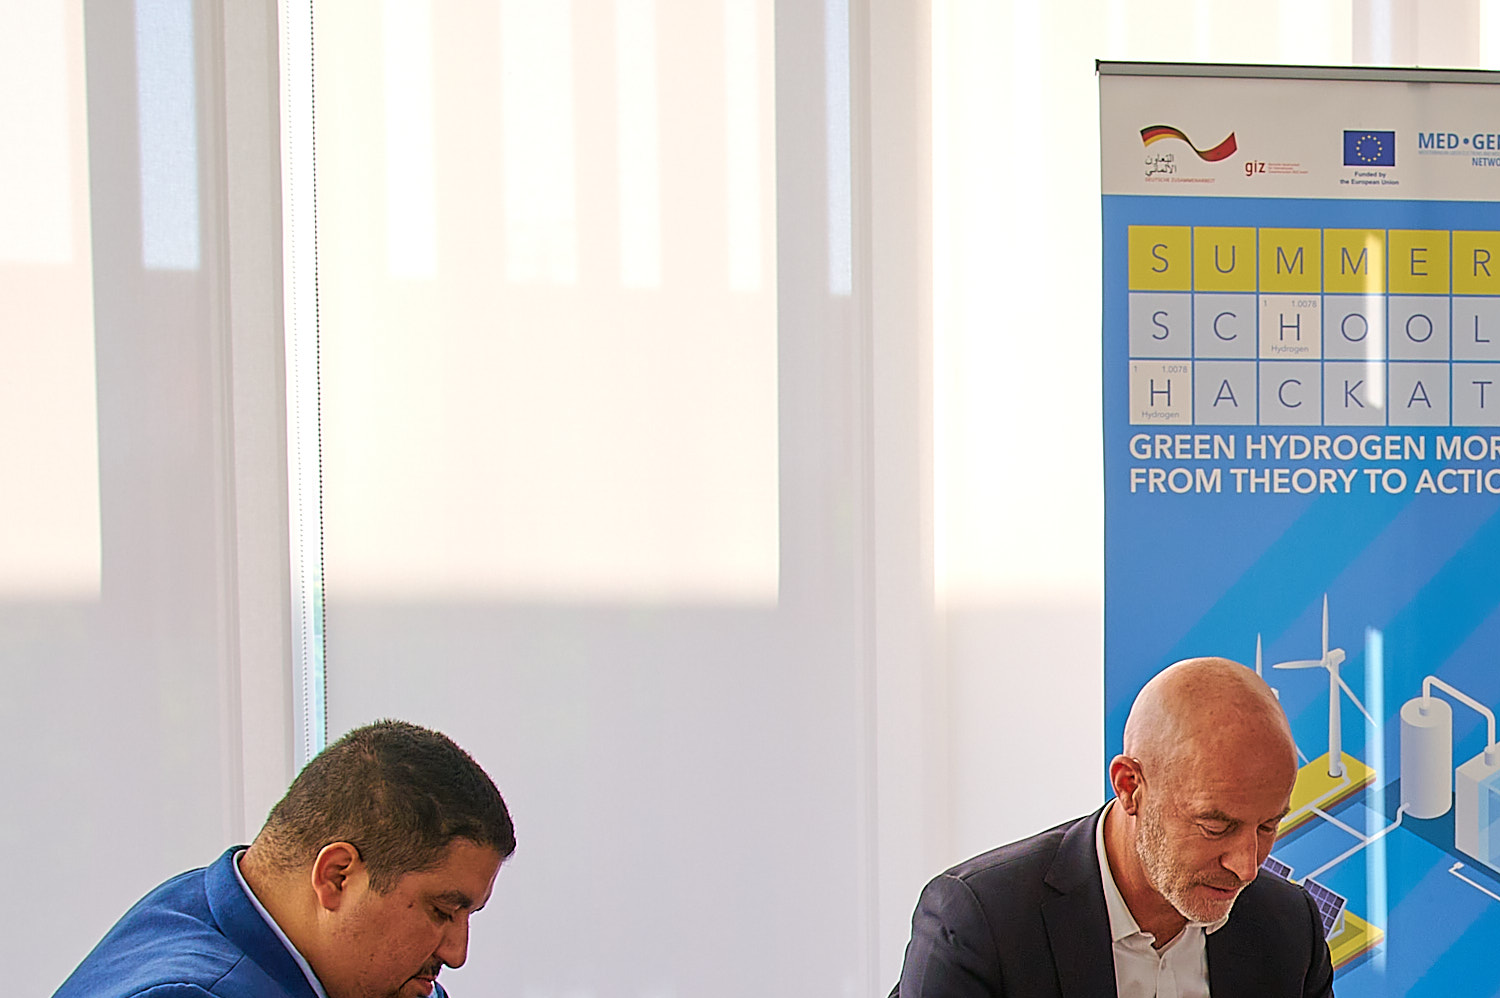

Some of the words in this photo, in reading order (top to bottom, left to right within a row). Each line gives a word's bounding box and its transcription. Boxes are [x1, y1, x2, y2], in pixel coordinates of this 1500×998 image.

[1245, 160, 1266, 176] giz
[1151, 244, 1491, 277] SUMMER
[1152, 311, 1490, 343] SCHOOL
[1271, 345, 1309, 354] Hydrogen
[1141, 411, 1180, 420] Hydrogen
[1129, 434, 1235, 460] GREEN
[1246, 434, 1425, 461] HYDROGEN
[1130, 468, 1222, 494] FROM
[1229, 468, 1358, 494] THEORY
[1364, 468, 1407, 494] TO
